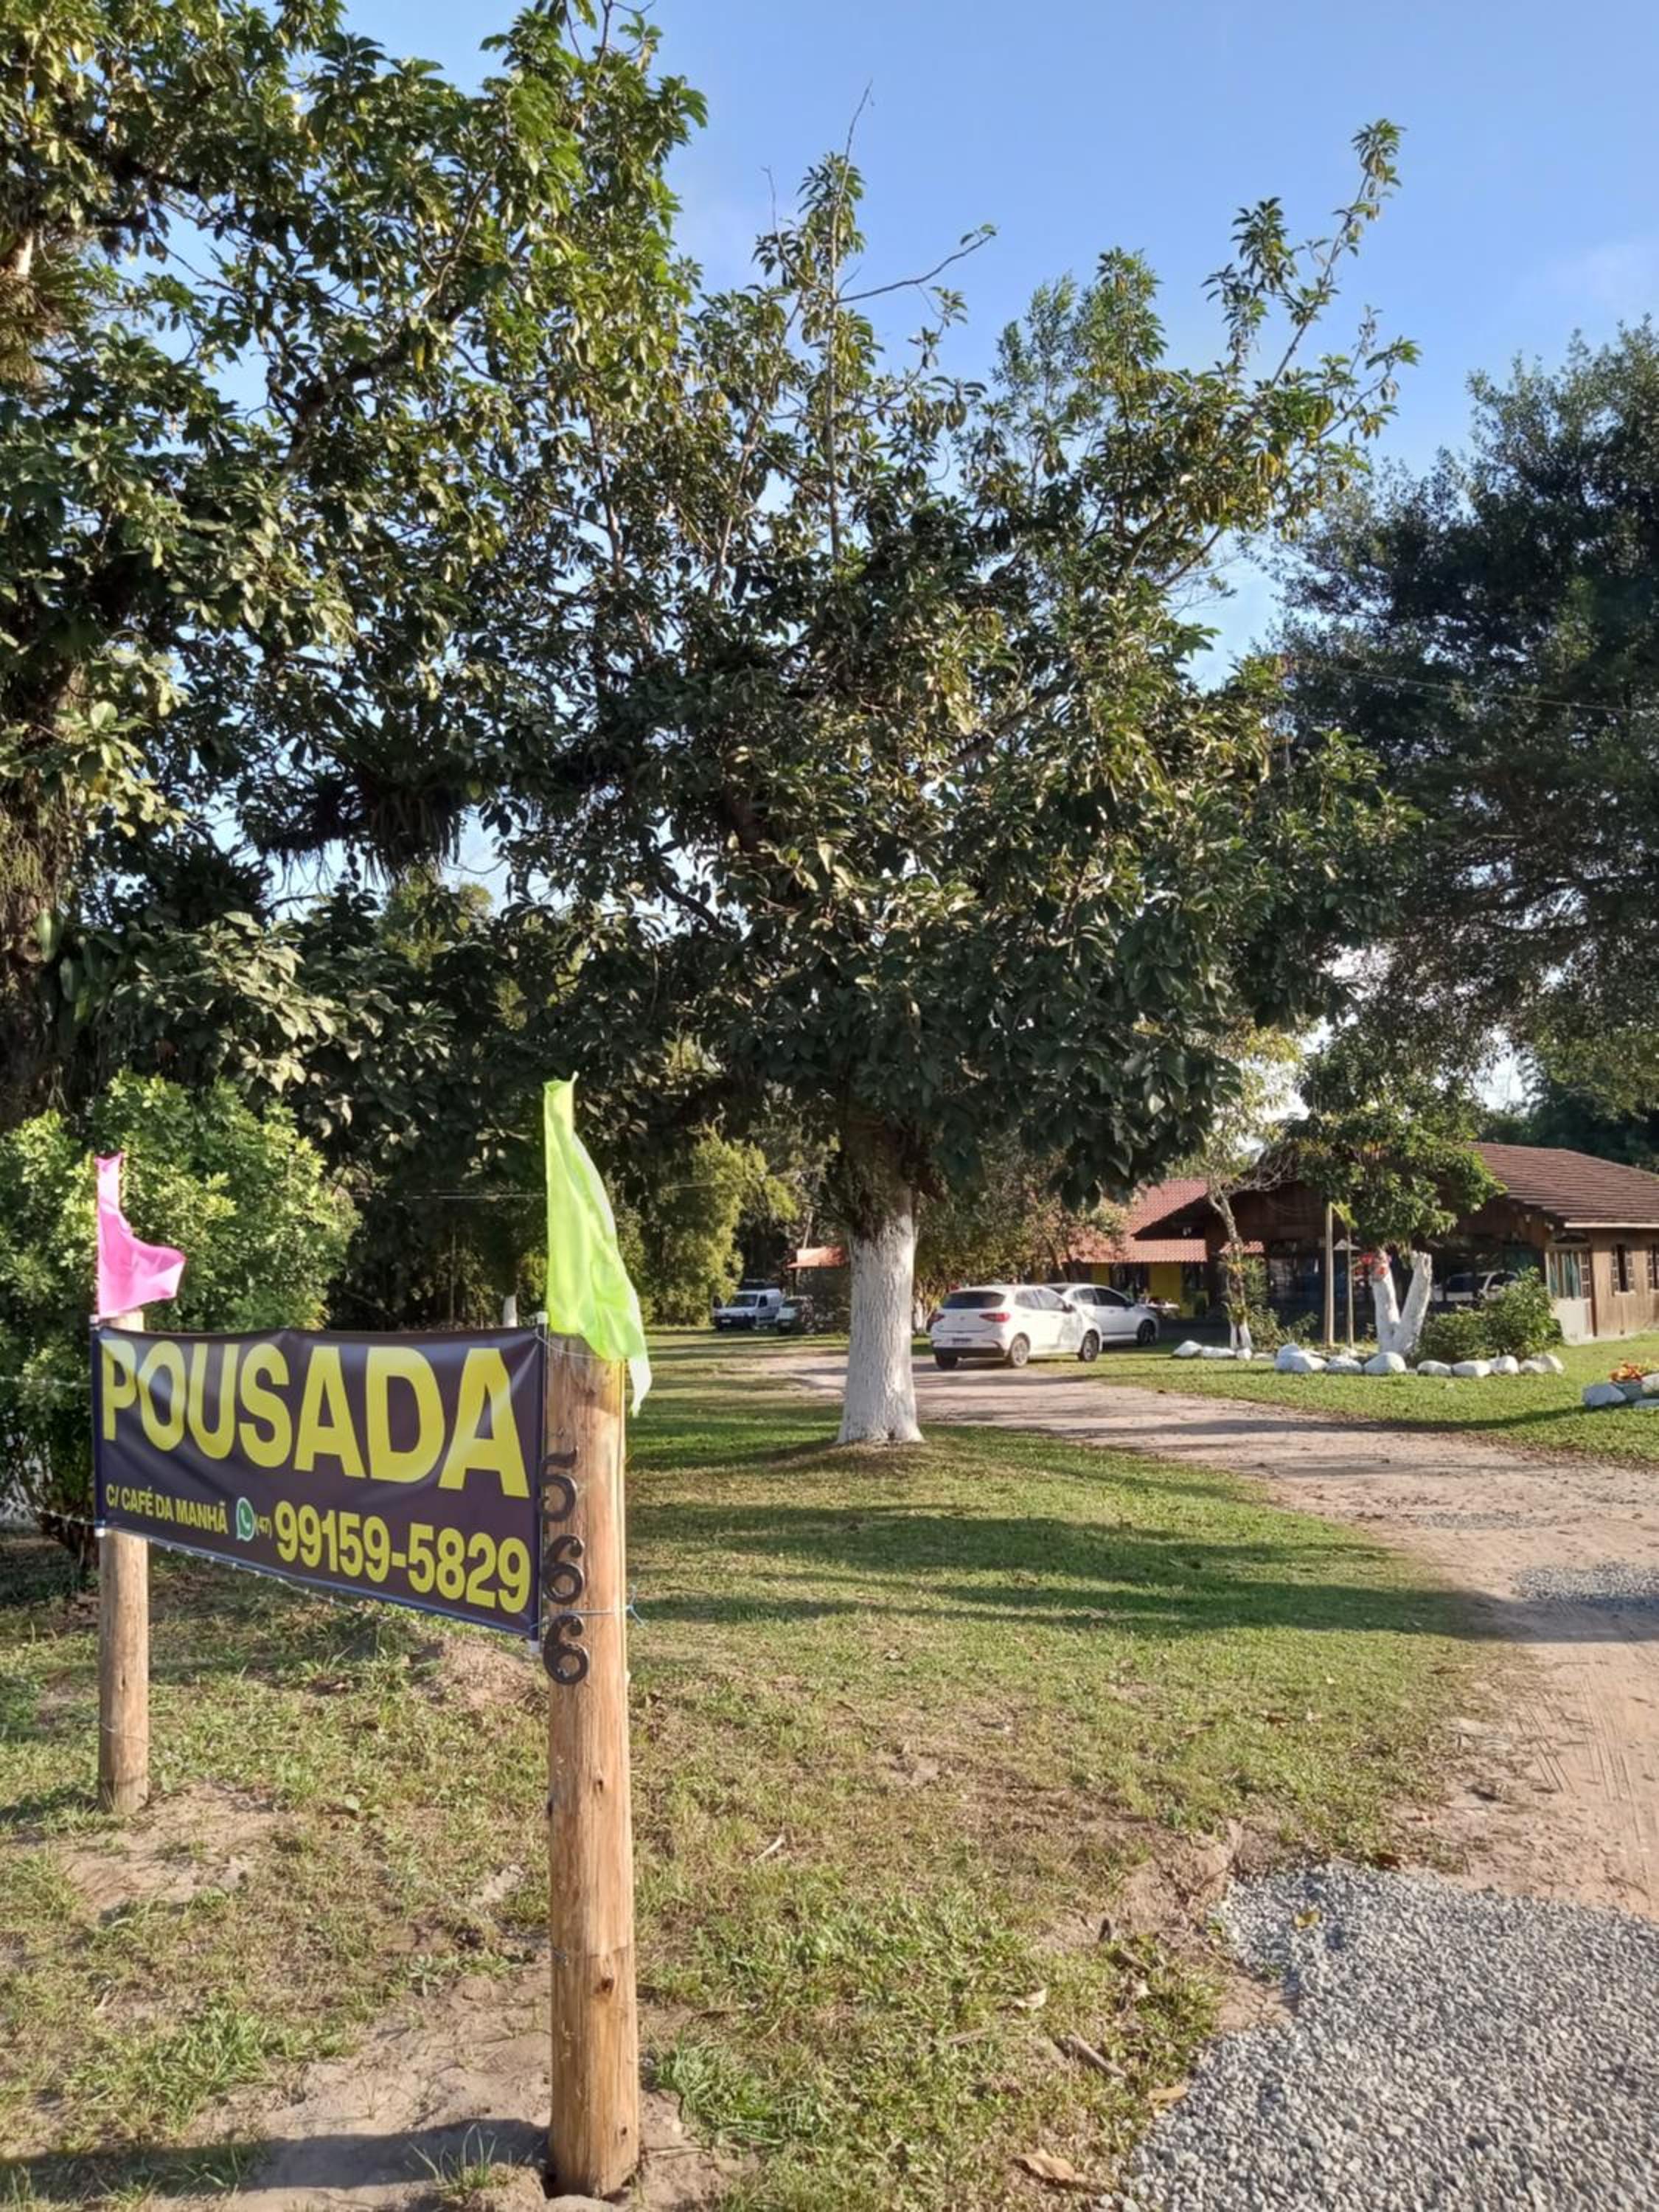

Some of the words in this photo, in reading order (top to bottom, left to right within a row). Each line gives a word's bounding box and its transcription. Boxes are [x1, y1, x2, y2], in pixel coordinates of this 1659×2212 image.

[100, 1340, 530, 1499] POUSADA
[105, 1484, 119, 1509] C/
[121, 1486, 153, 1517] CAFÉ
[156, 1494, 174, 1522] DA
[176, 1499, 229, 1534] MANHÃ
[275, 1500, 531, 1613] 99159-5829
